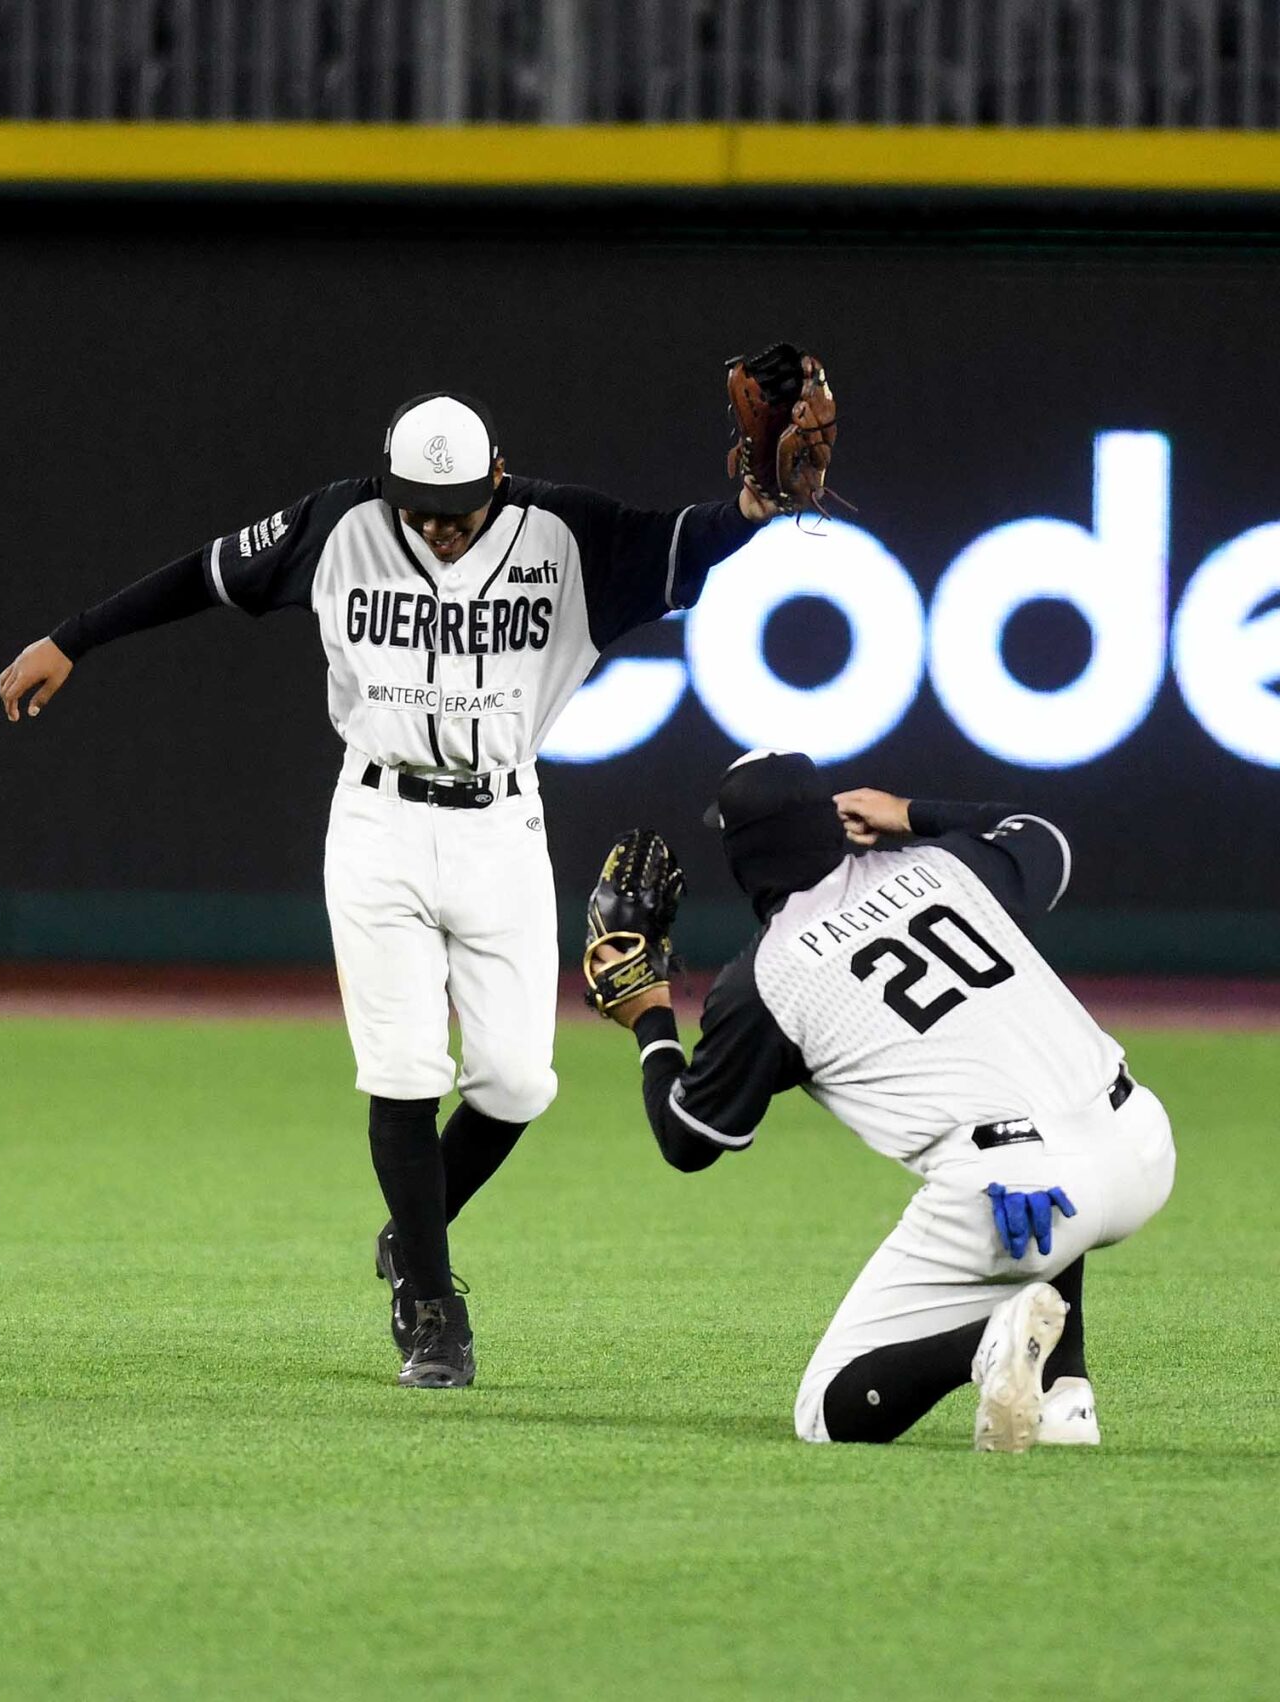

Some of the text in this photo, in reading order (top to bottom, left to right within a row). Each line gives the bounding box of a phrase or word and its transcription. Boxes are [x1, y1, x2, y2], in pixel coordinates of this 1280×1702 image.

[346, 587, 554, 655] GUERREROS
[799, 865, 942, 957] PACHECO
[850, 903, 1016, 1035] 20
